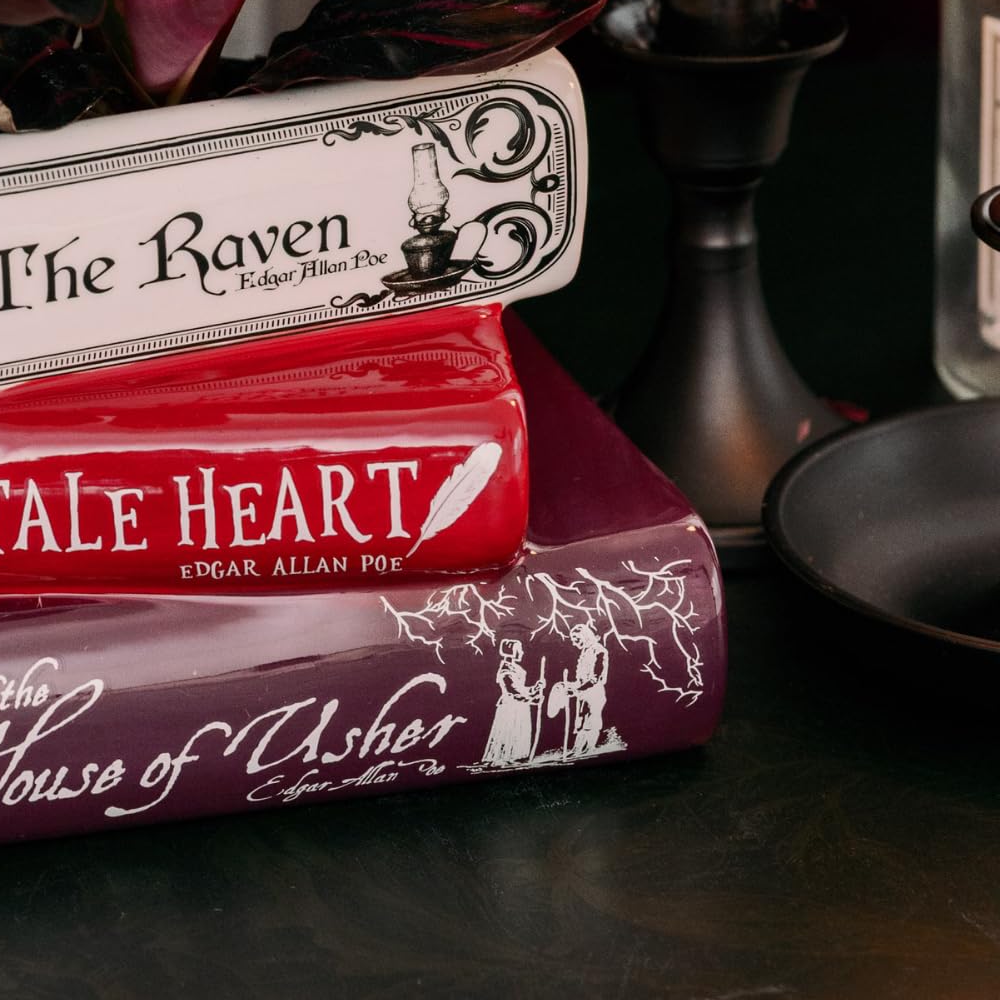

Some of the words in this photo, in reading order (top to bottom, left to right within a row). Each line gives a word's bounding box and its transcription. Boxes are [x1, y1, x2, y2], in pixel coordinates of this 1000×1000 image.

[138, 211, 351, 296] Raven
[235, 266, 297, 292] Edgar
[294, 258, 348, 287] Allan
[349, 249, 388, 273] Poe
[173, 460, 419, 551] HEART
[179, 560, 259, 580] EDGAR
[272, 556, 347, 578] ALLAN
[361, 554, 403, 573] POE
[0, 656, 59, 710] the
[104, 721, 232, 817] of
[223, 672, 468, 775] Usher
[246, 769, 333, 802] Edgar
[331, 761, 400, 791] Allan
